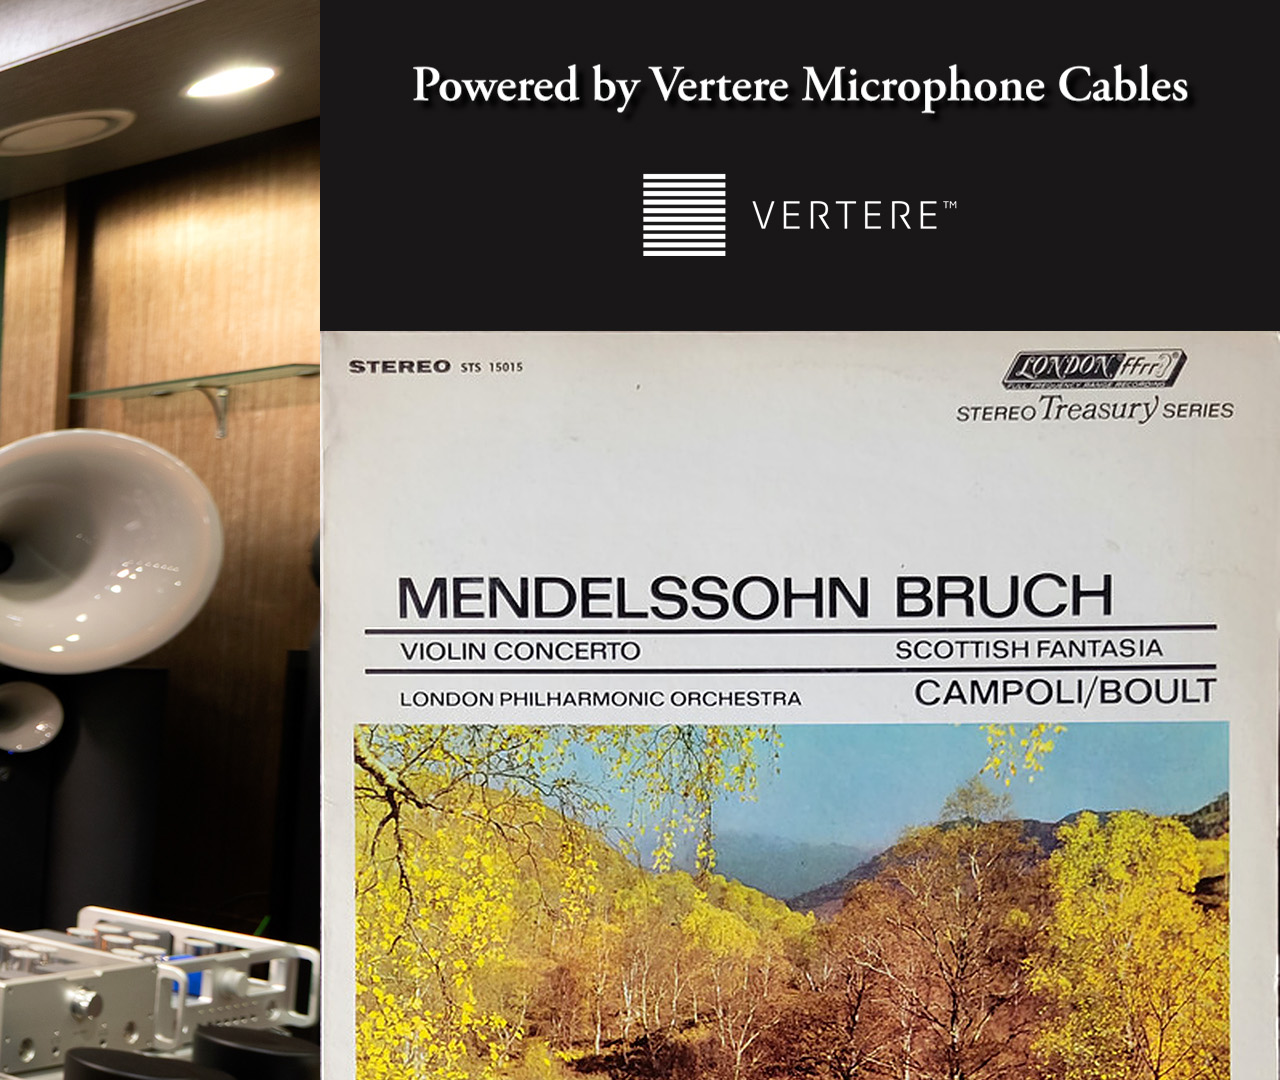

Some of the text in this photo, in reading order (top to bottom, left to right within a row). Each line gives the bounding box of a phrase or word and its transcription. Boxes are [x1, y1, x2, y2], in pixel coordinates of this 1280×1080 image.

[349, 359, 523, 374] STEREO STS 15015
[1015, 354, 1115, 379] LONDON
[956, 394, 1234, 424] STEREO Treasury SERIES
[398, 572, 1112, 621] MENDELSSOHN BRUCH
[400, 641, 641, 661] VIOLIN CONCERTO
[896, 638, 1164, 660] SCOTTISH FANTASIA
[400, 691, 802, 707] LONDON PHILHARMONIC ORCHESTRA
[914, 675, 1218, 710] CAMPOLI/BOULT
